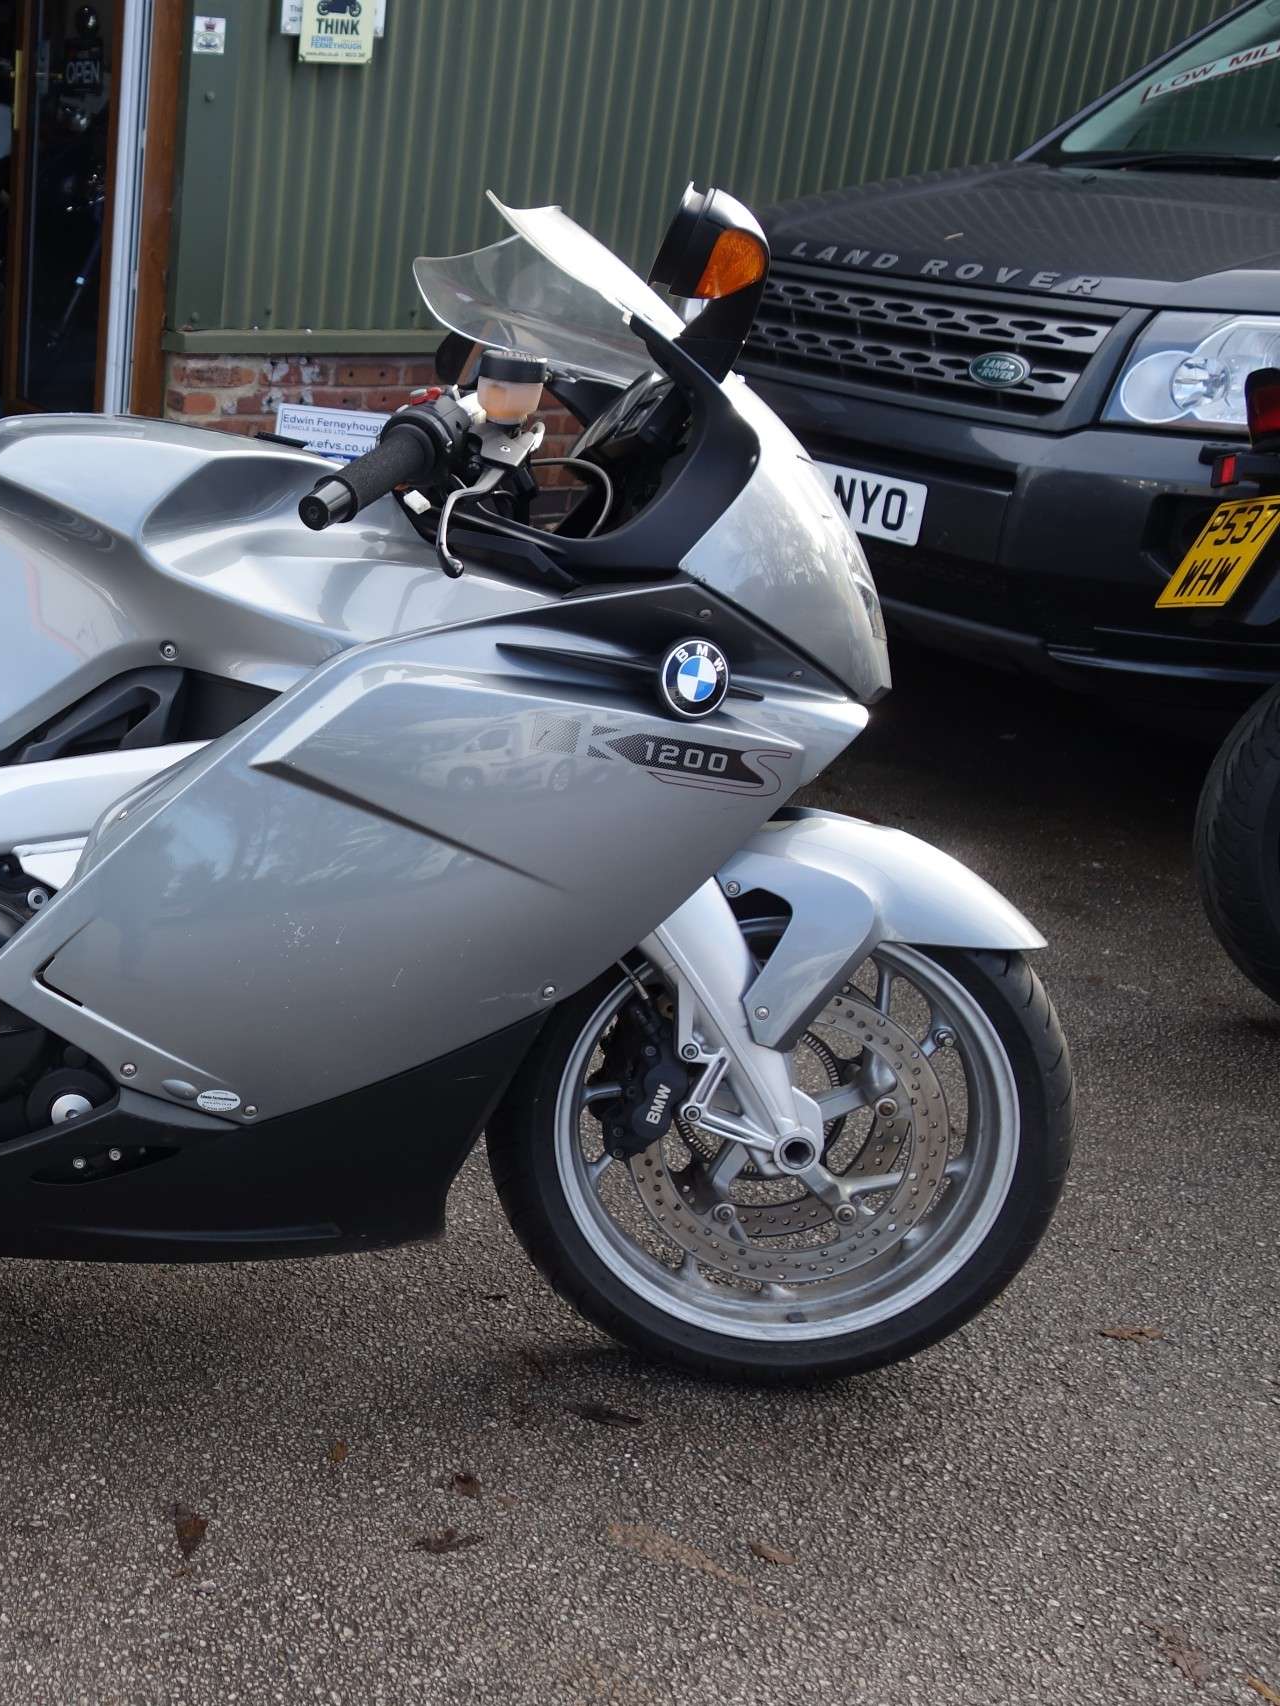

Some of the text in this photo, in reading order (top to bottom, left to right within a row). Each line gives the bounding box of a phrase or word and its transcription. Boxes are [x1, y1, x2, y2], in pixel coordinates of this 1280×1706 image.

[316, 18, 360, 35] THINK
[66, 61, 100, 84] OPEN
[1154, 64, 1216, 93] LOW
[790, 242, 1102, 295] LAND ROVER
[980, 367, 1015, 380] ROVER
[982, 359, 1010, 370] LAND
[282, 413, 315, 426] Edwin
[283, 424, 310, 432] VEHICLE
[311, 427, 333, 435] SALES
[1196, 504, 1280, 549] P537
[1173, 556, 1242, 597] WHW
[675, 643, 724, 673] BMW
[643, 740, 728, 773] 1200
[645, 1084, 671, 1124] BMW
